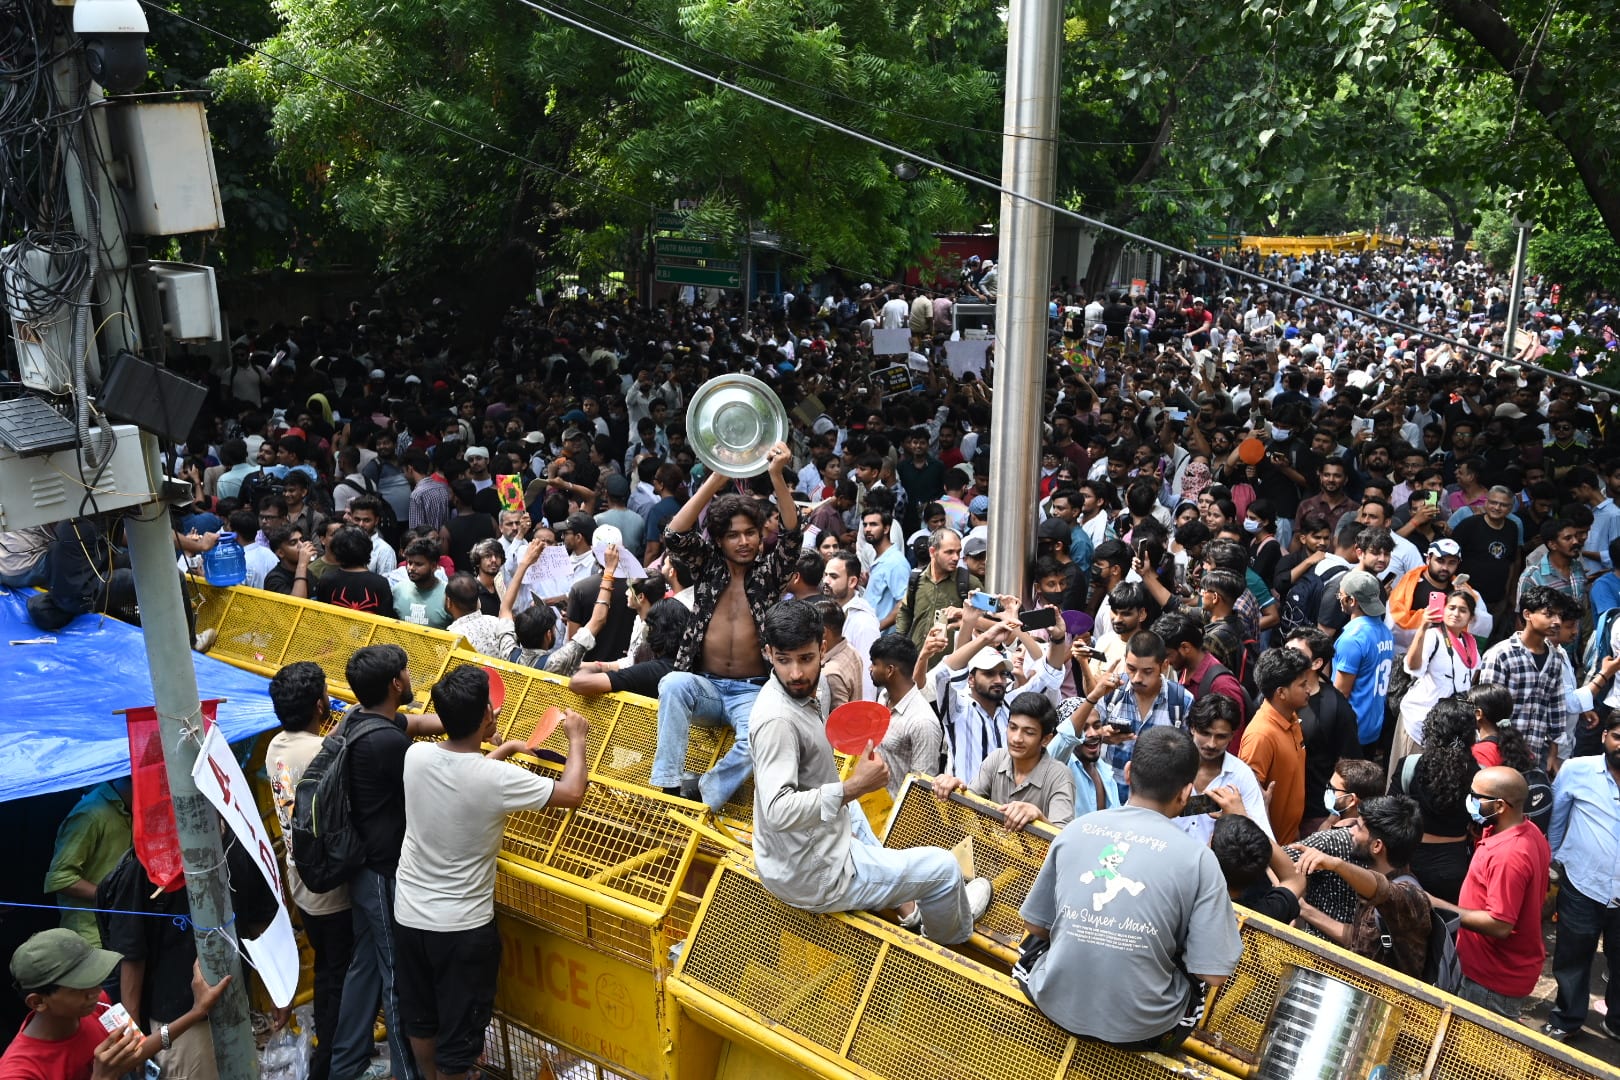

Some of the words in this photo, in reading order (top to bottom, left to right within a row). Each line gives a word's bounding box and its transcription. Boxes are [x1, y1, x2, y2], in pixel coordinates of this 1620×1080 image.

[1373, 658, 1392, 698] 13
[1081, 822, 1122, 843] Rising
[1124, 830, 1168, 852] Energy
[1061, 905, 1079, 920] The
[1080, 908, 1116, 928] Super
[501, 936, 591, 1009] OLICE
[572, 1024, 630, 1065] DISTRICT
